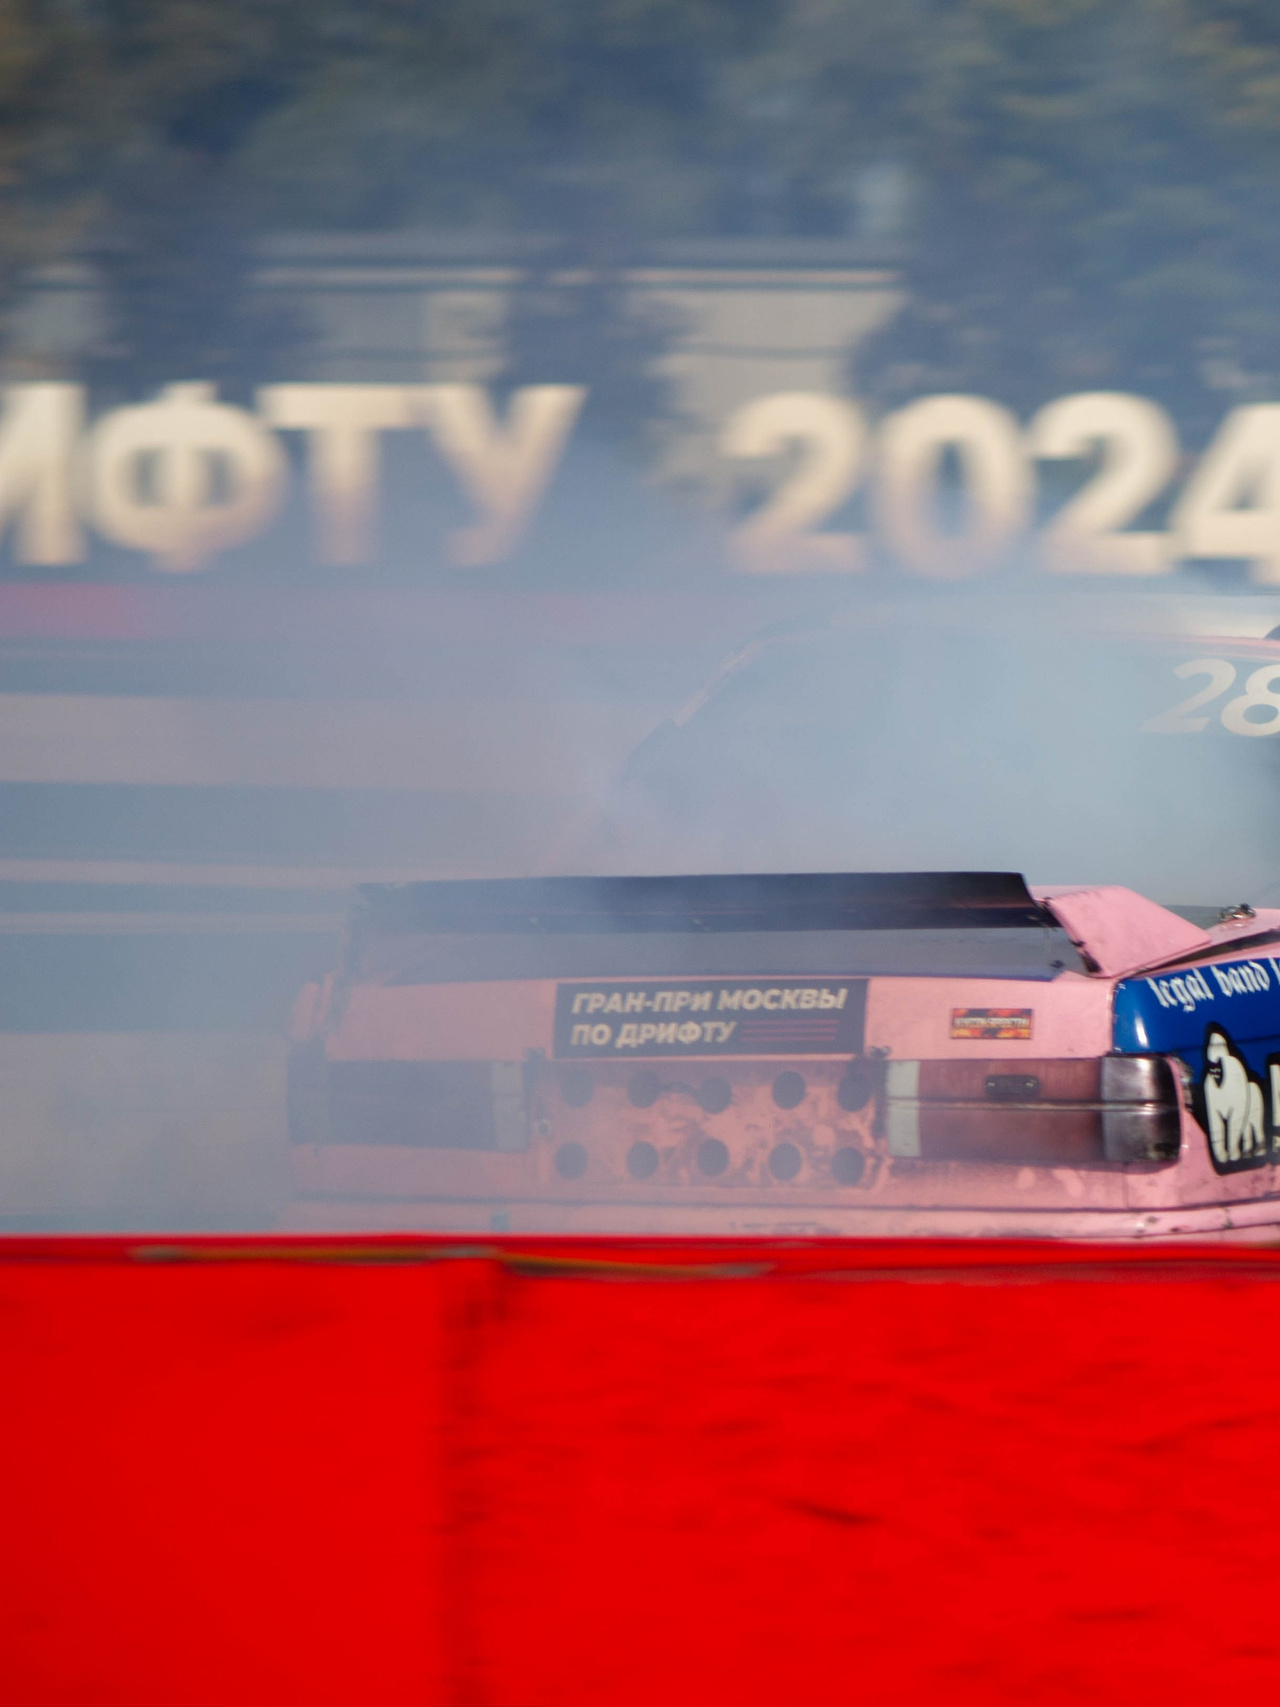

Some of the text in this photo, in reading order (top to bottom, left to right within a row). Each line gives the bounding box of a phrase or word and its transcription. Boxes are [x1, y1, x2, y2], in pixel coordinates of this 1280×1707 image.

[1145, 967, 1215, 1013] legal
[1210, 959, 1271, 998] band
[571, 988, 849, 1014] ГРАН-ПРИ МОСКВЫ
[571, 1021, 738, 1048] ПО ДРИФТУ
